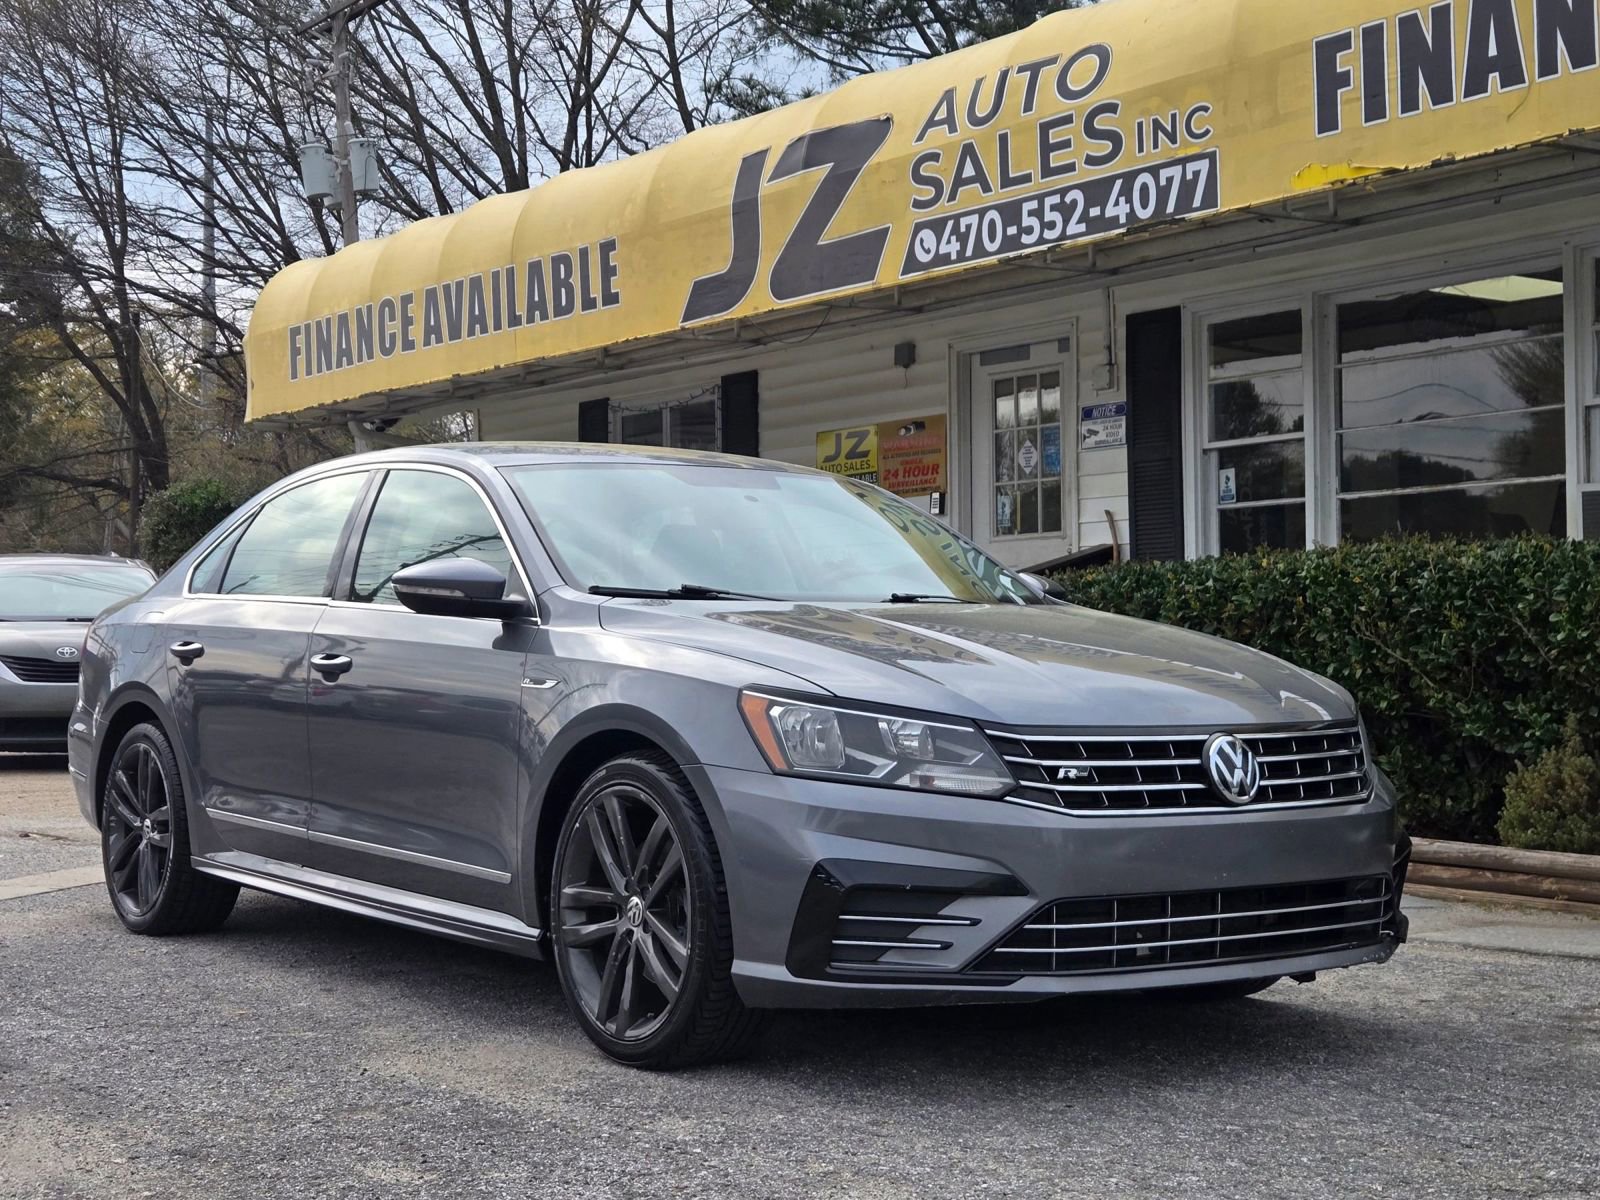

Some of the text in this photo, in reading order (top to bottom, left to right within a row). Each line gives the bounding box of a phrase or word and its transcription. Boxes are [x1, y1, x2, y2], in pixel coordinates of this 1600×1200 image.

[912, 42, 1113, 146] AUTO
[910, 100, 1214, 213] SALES INC
[679, 112, 893, 329] JZ
[939, 158, 1210, 261] 470-552-4077
[288, 236, 621, 382] FINANCE AVAILABLE
[822, 429, 871, 463] JZ
[1092, 405, 1117, 418] NOTICE
[844, 459, 870, 472] SALES
[883, 464, 940, 481] 24 HOUR
